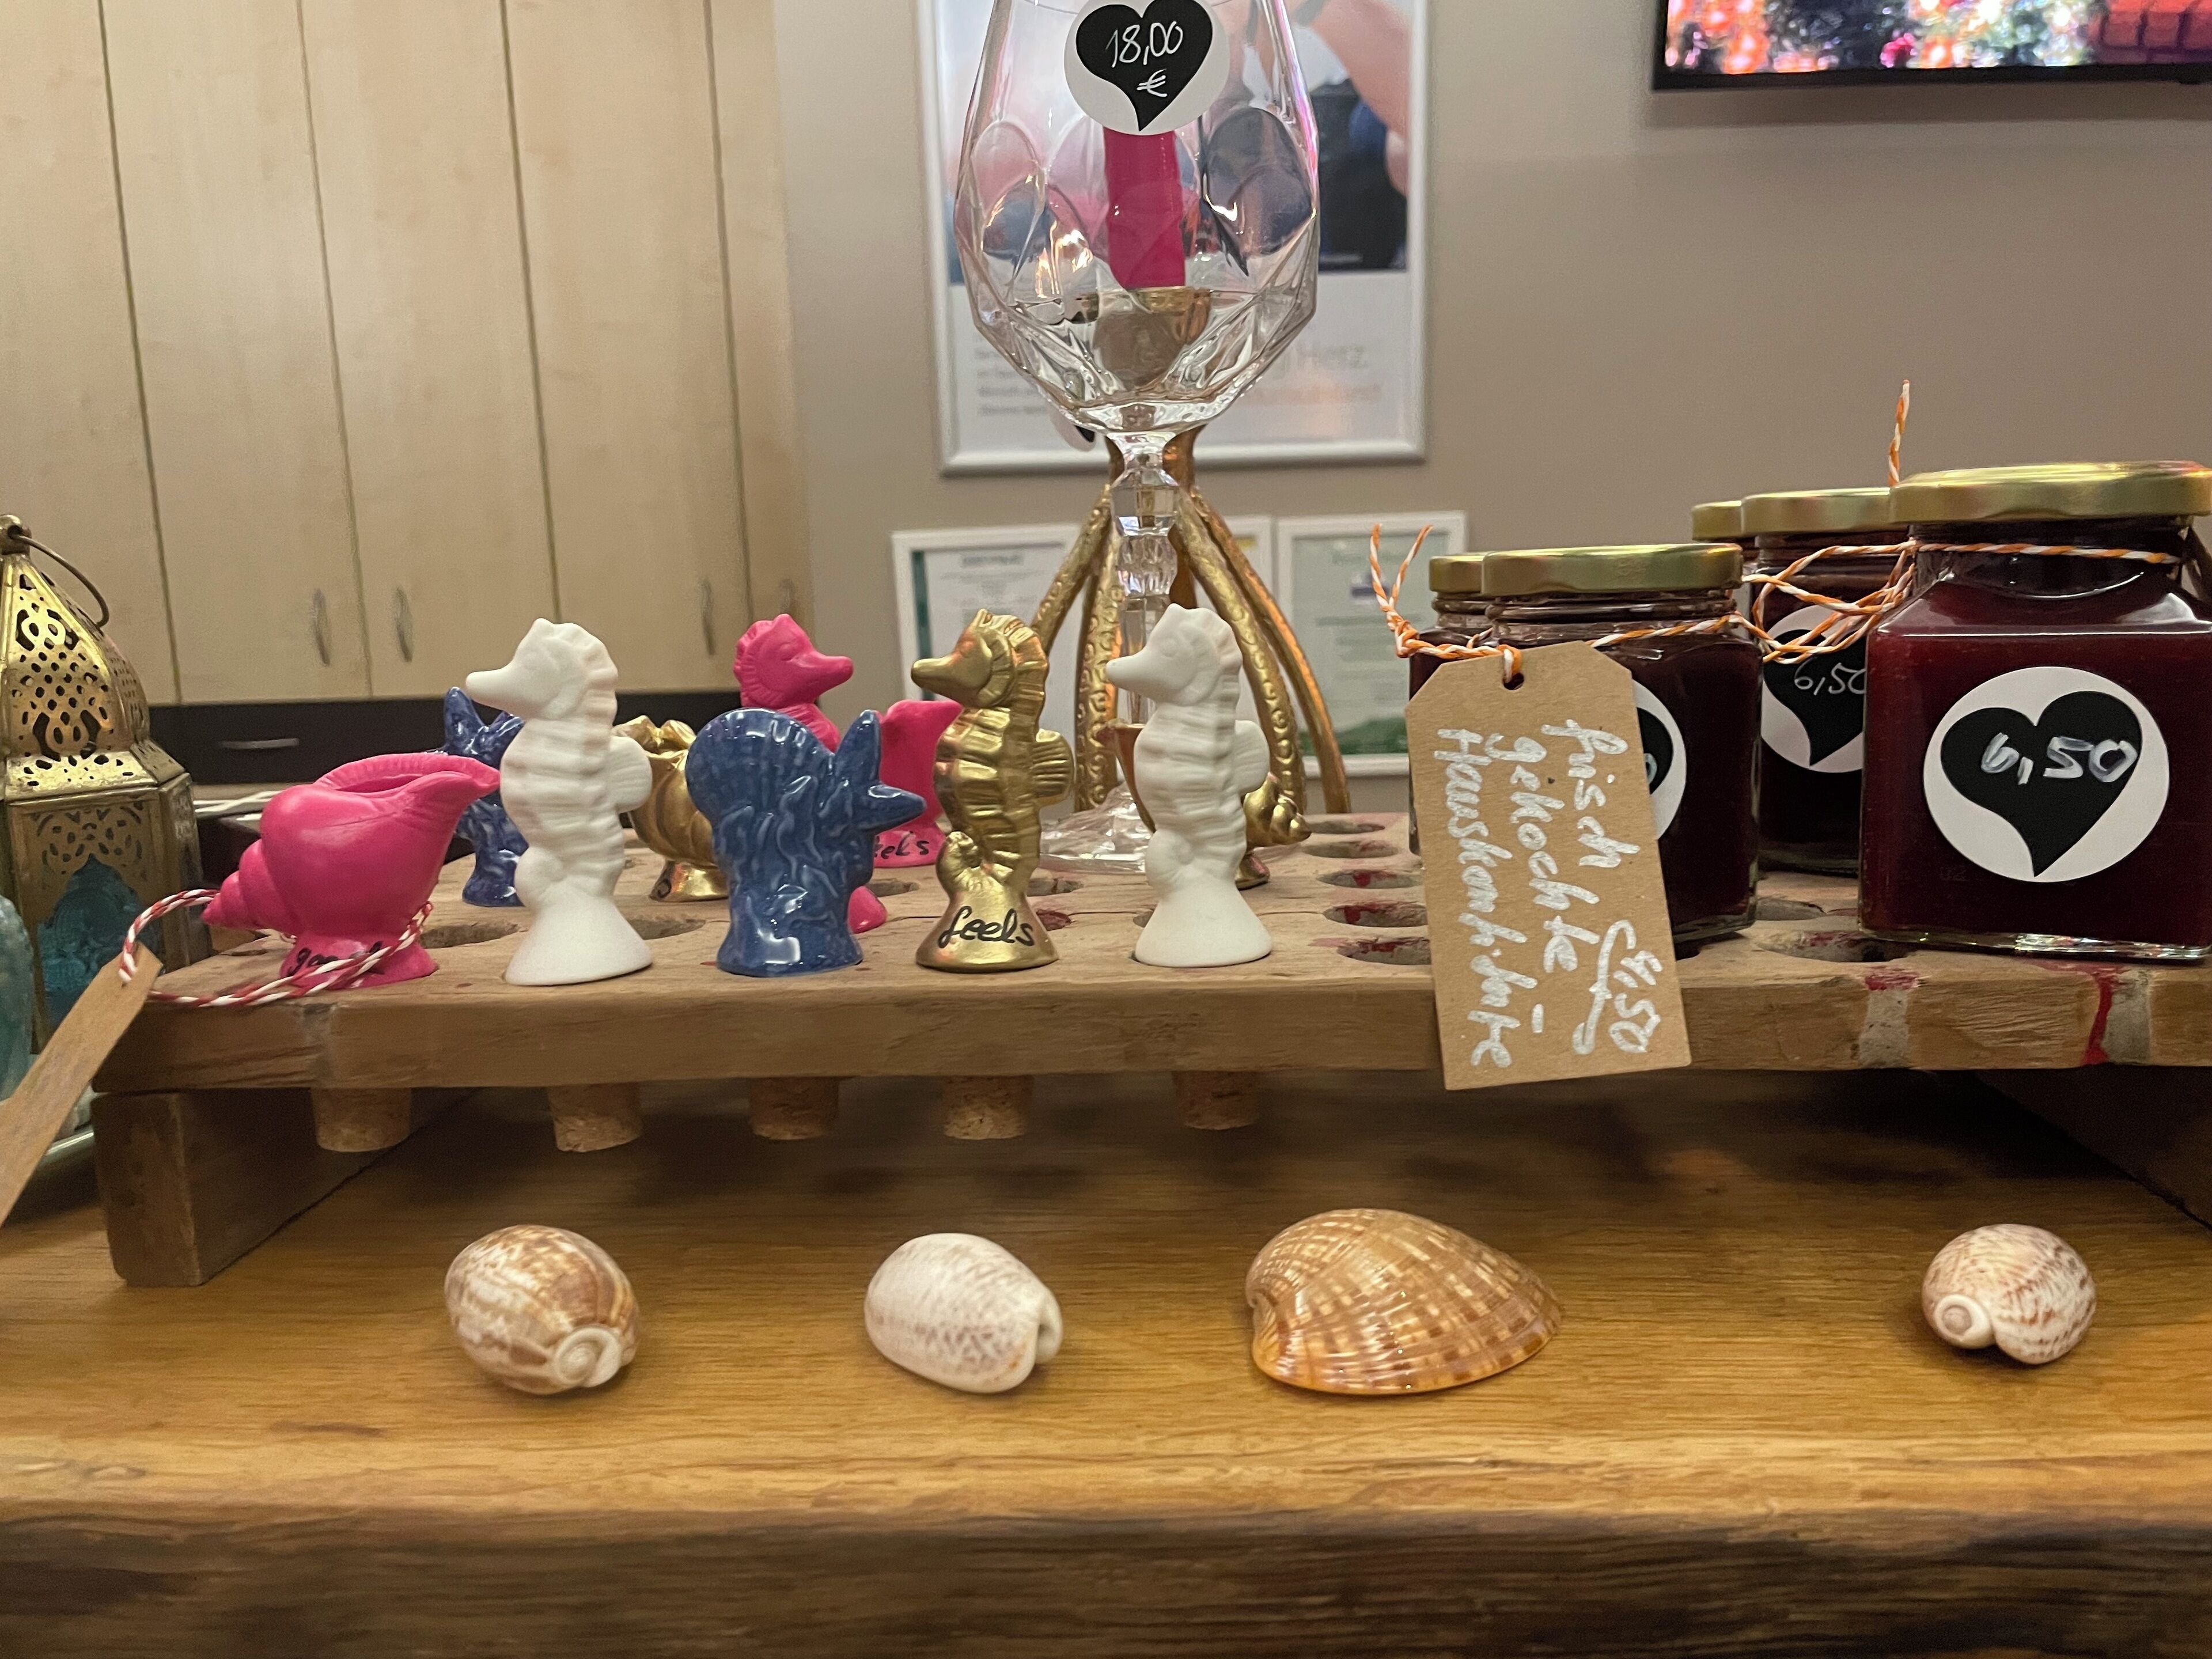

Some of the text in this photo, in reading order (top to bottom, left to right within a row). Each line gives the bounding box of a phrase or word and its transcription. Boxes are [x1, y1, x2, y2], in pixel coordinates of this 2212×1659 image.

[1105, 21, 1183, 69] 18,00
[1137, 68, 1168, 97] €
[1980, 732, 2138, 785] 6,50
[1541, 719, 1641, 868] frisch
[1484, 733, 1600, 974] gekochte
